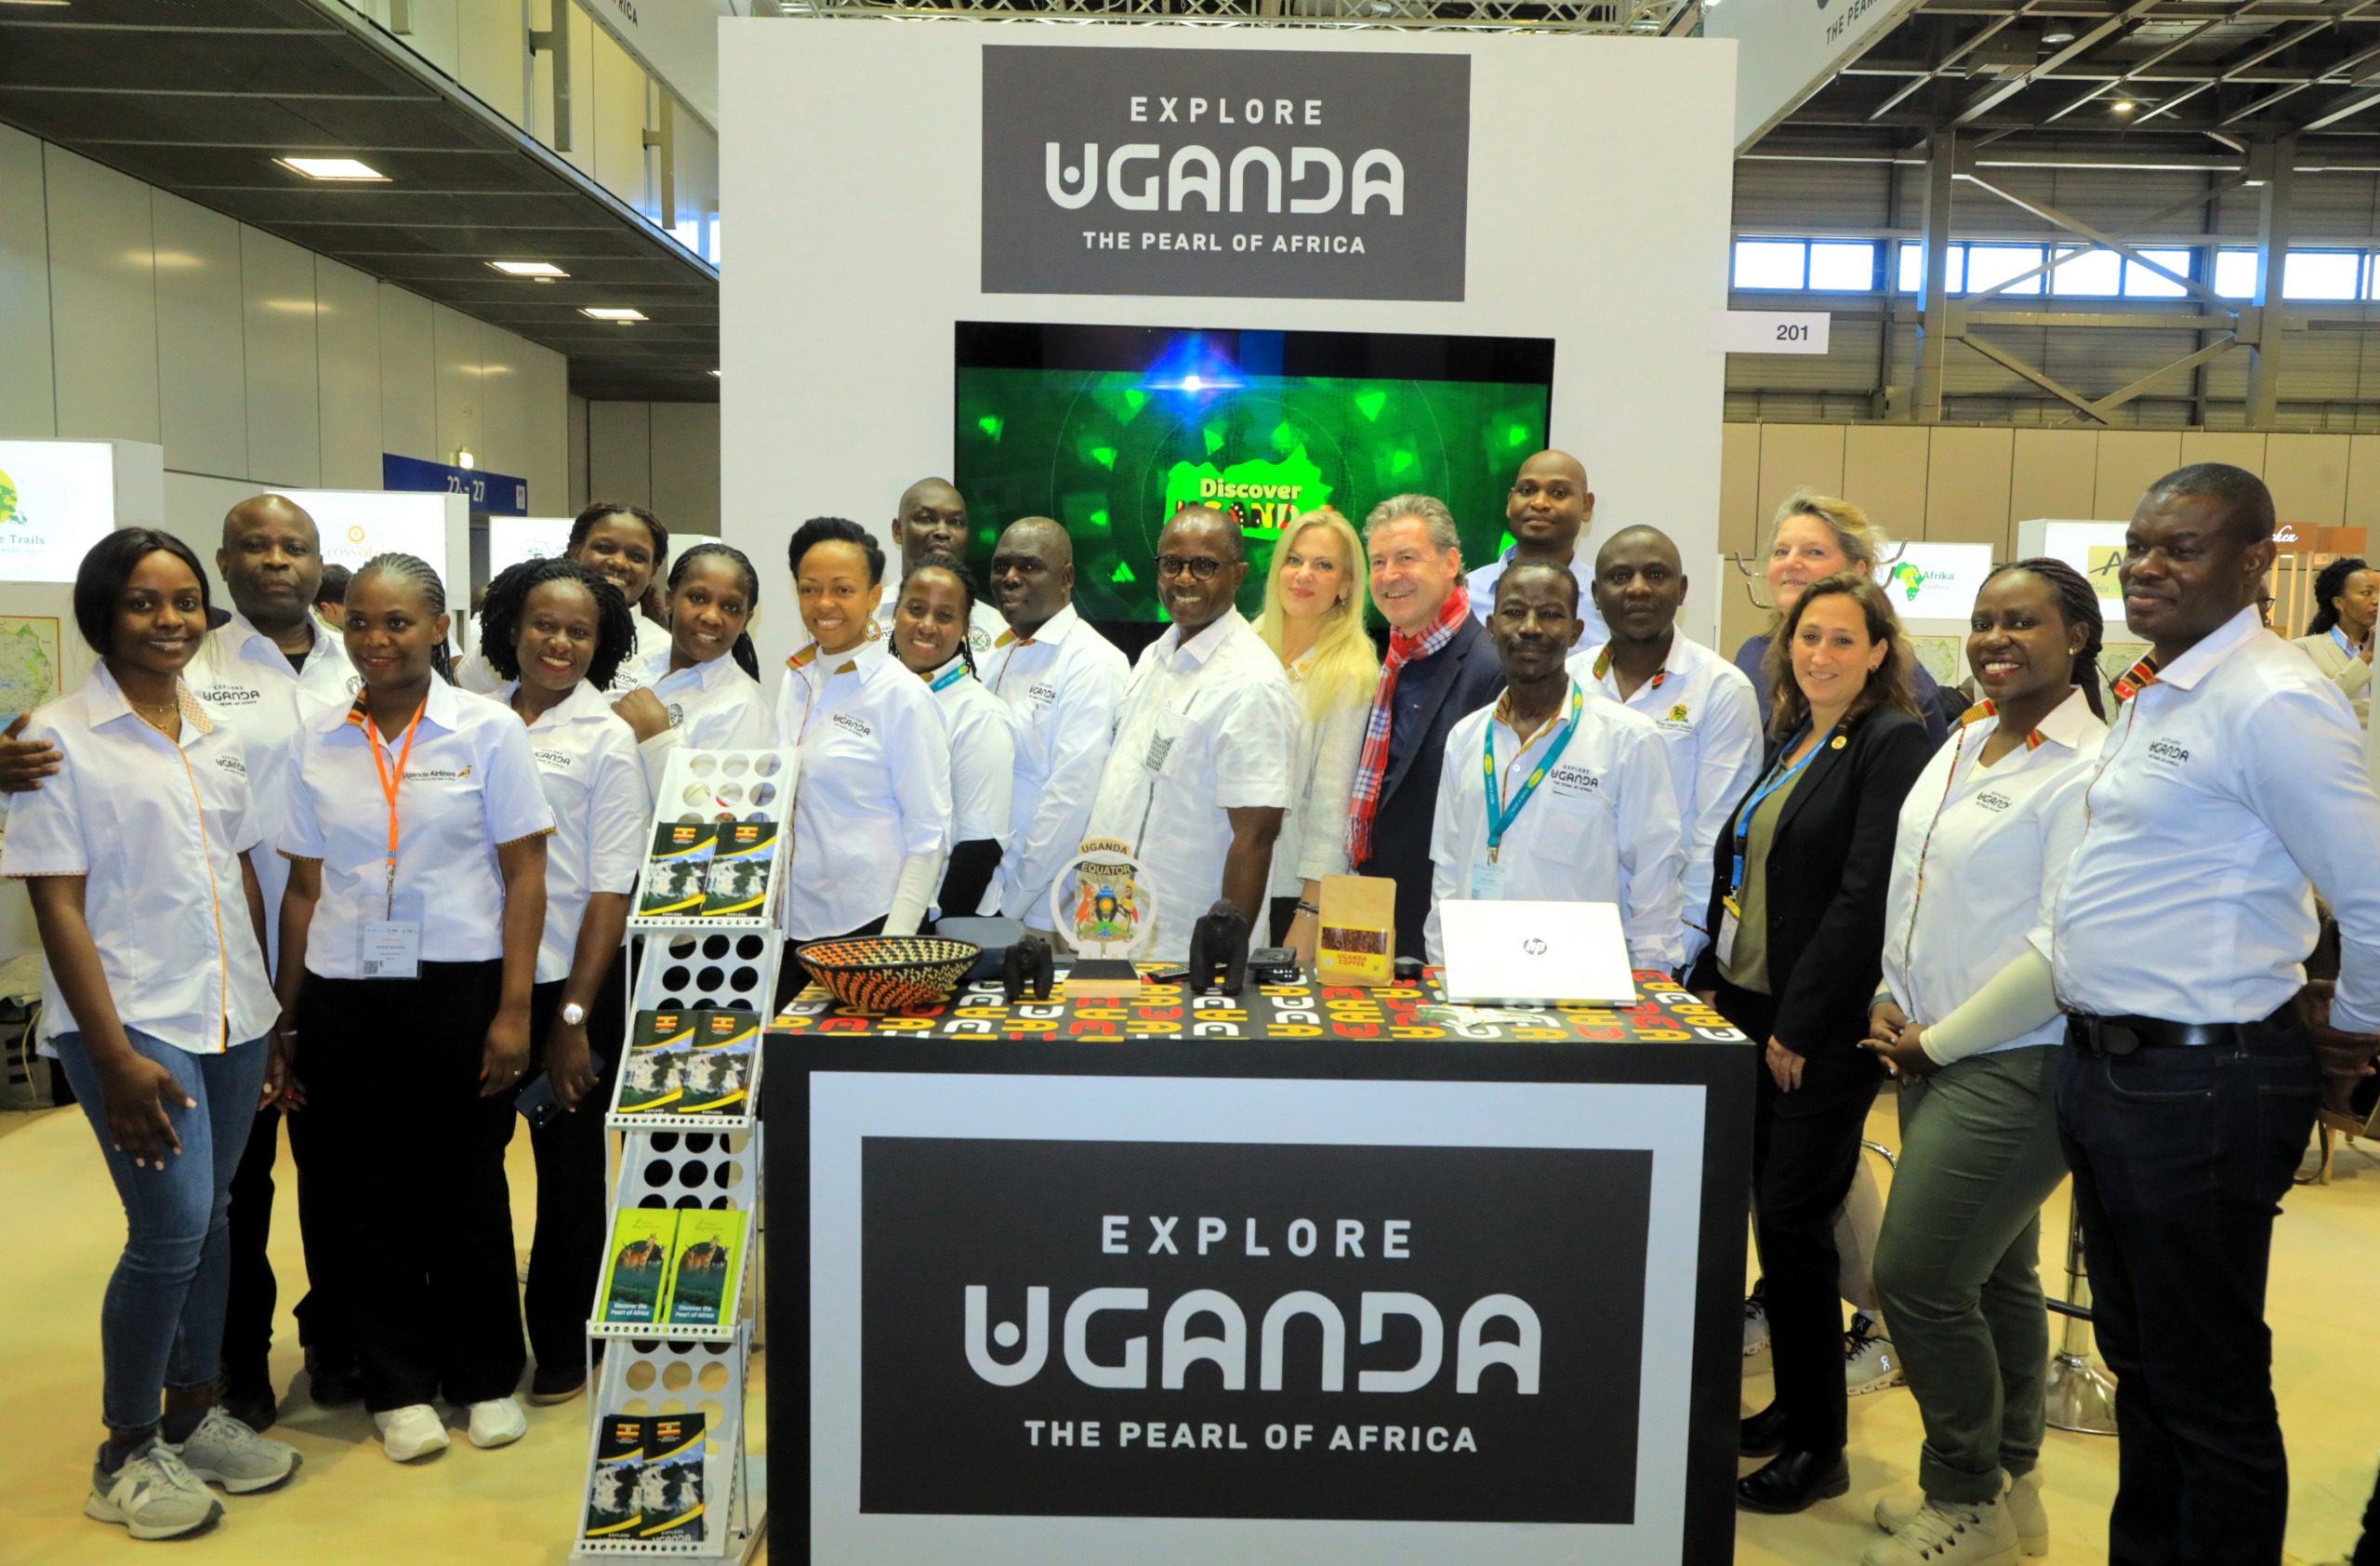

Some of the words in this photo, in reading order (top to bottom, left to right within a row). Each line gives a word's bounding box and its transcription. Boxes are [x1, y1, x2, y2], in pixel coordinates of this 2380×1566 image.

[611, 0, 638, 28] RICA
[1827, 15, 1844, 45] THE
[1130, 96, 1322, 126] EXPLORE
[1045, 141, 1405, 216] UGANDA
[1082, 231, 1130, 250] THE
[1142, 232, 1223, 251] PEARL
[1232, 233, 1263, 252] OF
[1272, 234, 1366, 254] AFRICA
[1776, 325, 1808, 341] 201
[472, 480, 484, 502] 27
[1199, 477, 1302, 500] Discover
[1176, 500, 1333, 529] AND
[9, 535, 46, 545] Trails
[1924, 571, 1954, 580] Afrika
[615, 672, 638, 684] ANDA
[202, 690, 260, 701] UGANDA
[833, 714, 871, 737] UGANDA
[2149, 741, 2189, 763] UGANDA
[1551, 769, 1599, 789] UGANDA
[1563, 764, 1591, 775] EXPLORE
[1977, 791, 2013, 809] UGAND
[1081, 843, 1128, 855] UGANDA
[1080, 862, 1131, 875] EQUATOR
[1523, 937, 1547, 956] hp
[1338, 959, 1366, 967] COFFEE
[1102, 1214, 1411, 1258] EXPLORE
[964, 1284, 1541, 1395] UGANDA
[1024, 1420, 1101, 1447] THE
[1119, 1422, 1248, 1449] PEARL
[1264, 1424, 1314, 1450] OF
[1329, 1425, 1477, 1453] AFRICA
